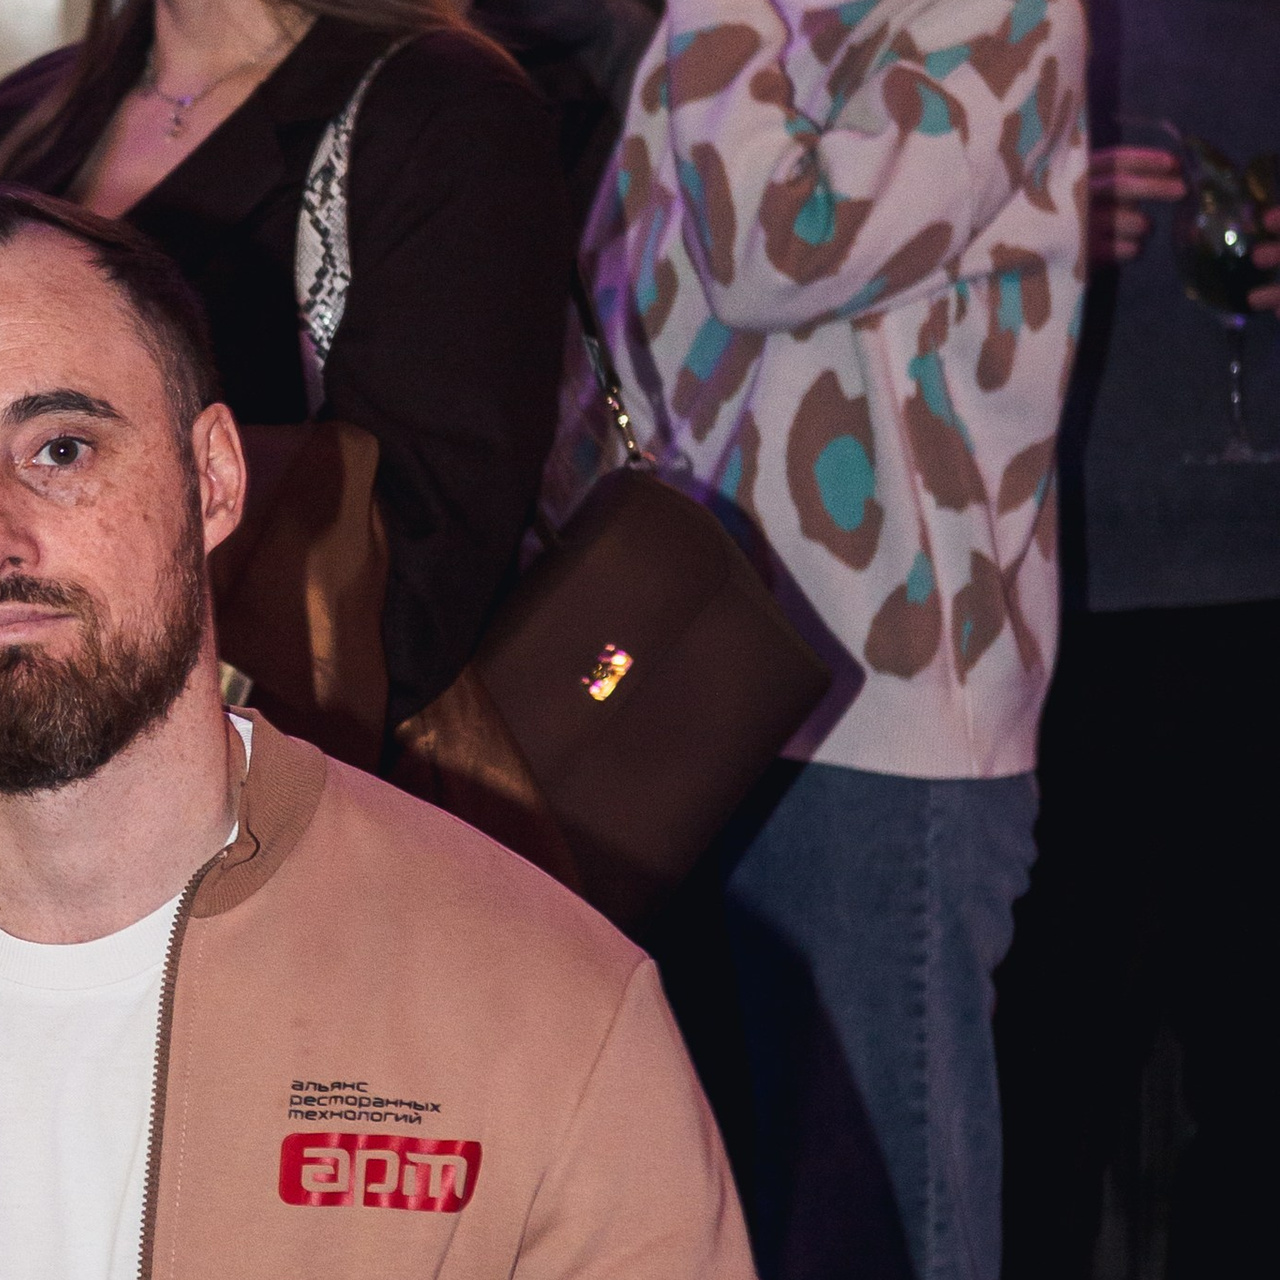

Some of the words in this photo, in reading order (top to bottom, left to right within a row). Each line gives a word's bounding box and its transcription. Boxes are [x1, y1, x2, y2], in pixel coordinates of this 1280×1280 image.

[290, 1079, 369, 1093] альянс
[289, 1094, 442, 1113] ресторанных
[287, 1108, 422, 1125] технологий
